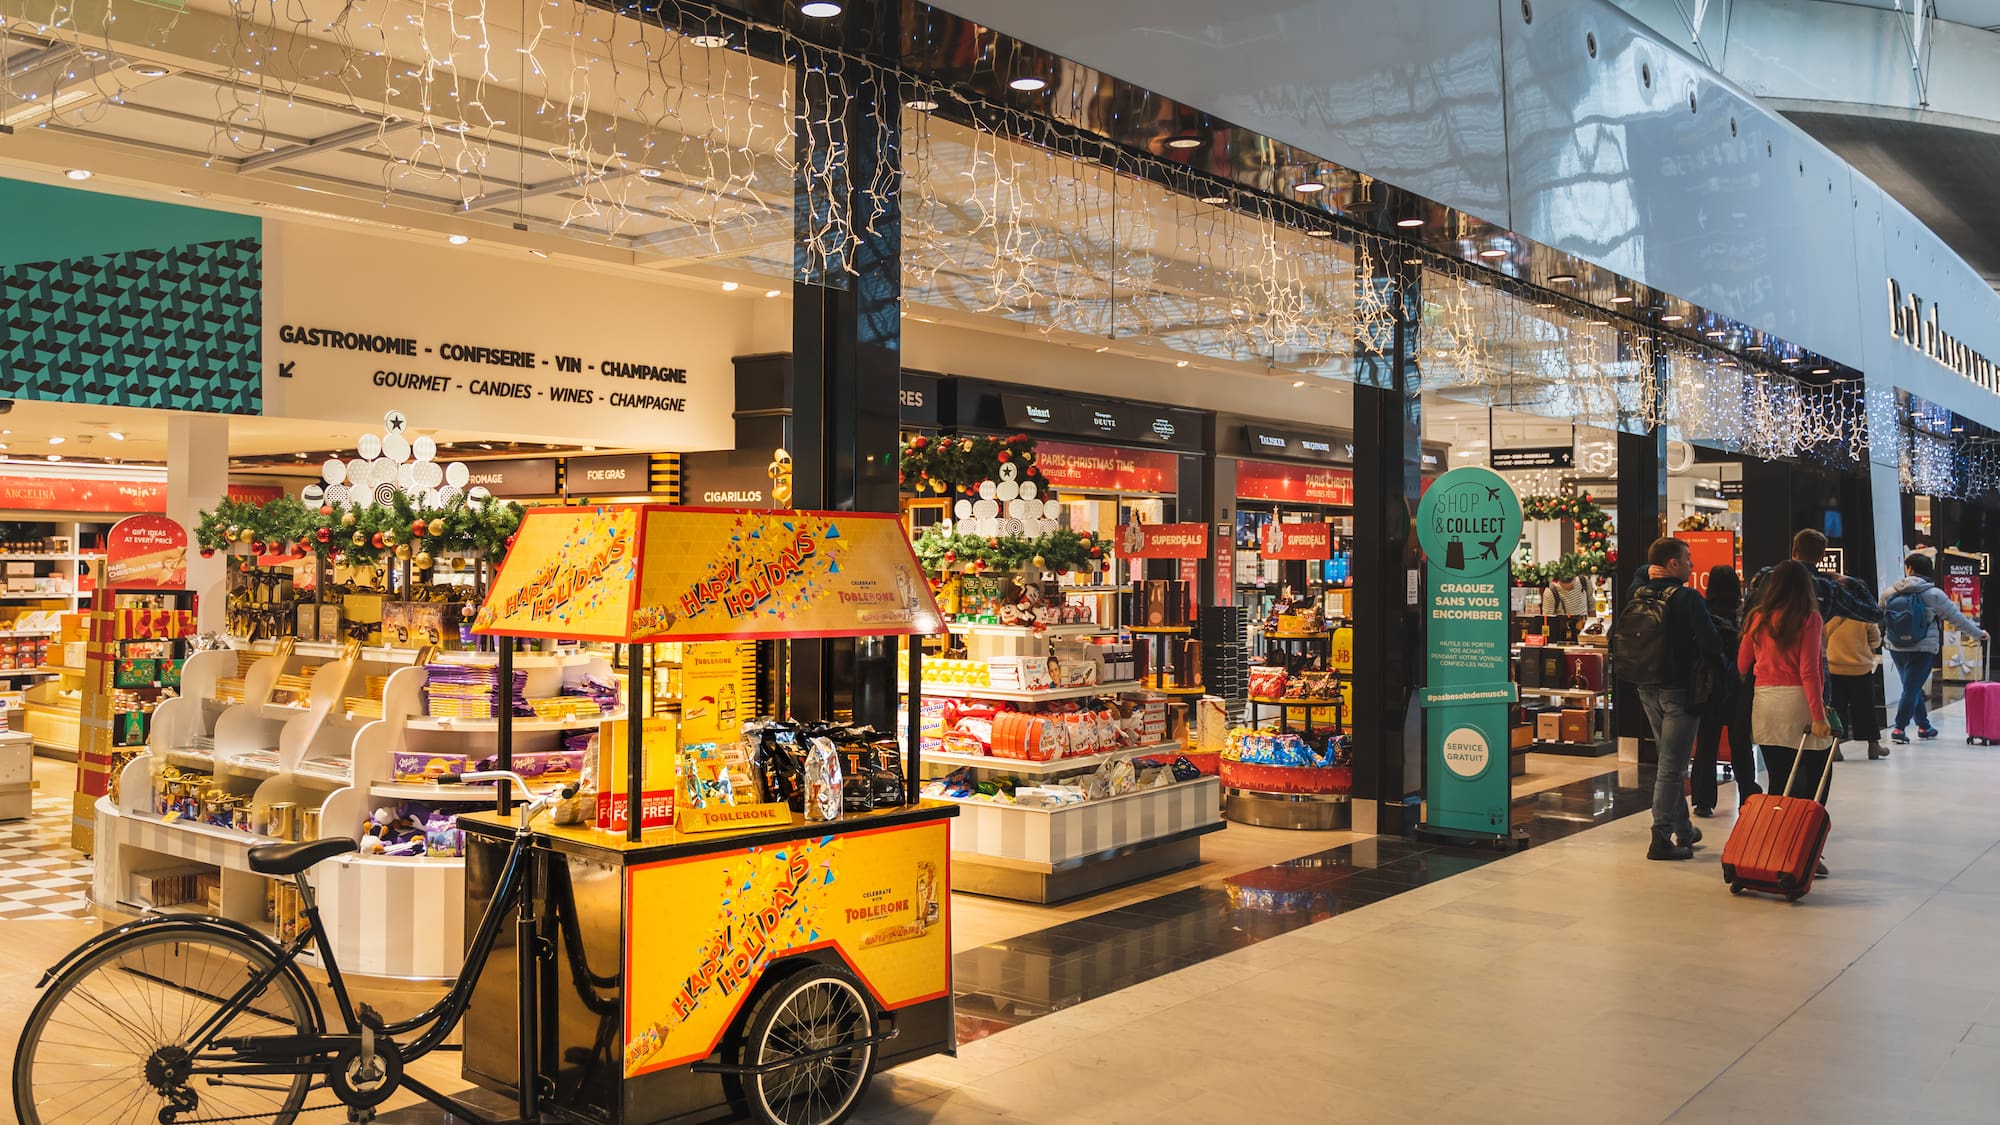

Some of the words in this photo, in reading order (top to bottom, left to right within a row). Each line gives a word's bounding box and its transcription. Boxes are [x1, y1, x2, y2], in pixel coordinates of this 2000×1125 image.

[279, 325, 417, 356] GASTRONOMIE
[440, 343, 535, 368] CONFISERIE
[555, 356, 582, 373] VIN
[600, 361, 687, 384] CHAMPAGNE
[373, 371, 452, 392] GOURMET
[469, 380, 532, 399] CANDIES
[550, 387, 594, 404] WINES
[610, 392, 686, 412] CHAMPAGNE
[1094, 418, 1116, 427] DEUTZ
[1042, 453, 1065, 466] PARIS
[1067, 456, 1114, 470] CHRISTMAS
[1116, 459, 1134, 472] TIME
[469, 474, 503, 484] ROMAGE
[587, 470, 604, 481] FOIE
[604, 469, 626, 480] GRAS
[1306, 474, 1324, 488] PARIS
[5, 487, 56, 500] ANGELINA
[704, 490, 762, 503] CIGARILLOS
[1438, 493, 1480, 514] SHOP
[1446, 518, 1506, 534] COLLECT
[1152, 534, 1202, 546] SUPERDEALS
[1288, 530, 1326, 546] SUPERDEALS
[108, 563, 126, 572] PARIS
[724, 530, 816, 618] HOLIDAYS
[532, 536, 626, 620] HOLIDAYS
[1952, 576, 1972, 584] -30%
[505, 564, 560, 618] HAPPY
[680, 558, 742, 618] HAPPY
[1440, 584, 1494, 594] CRAQUEZ
[838, 592, 896, 604] TOBLERONE
[1436, 597, 1465, 606] SANS
[1468, 598, 1500, 607] VOUS
[1432, 610, 1502, 620] ENCOMBRER
[696, 658, 732, 666] TOBLERONE
[1428, 690, 1508, 702] #pasbesoindemuscle
[1447, 743, 1483, 752] SERVICE
[513, 757, 536, 769] Milka
[1447, 753, 1484, 762] GRATUIT
[642, 804, 672, 819] FREE
[703, 809, 776, 825] TOBLERONE
[863, 888, 892, 898] CELEBRATE
[845, 899, 909, 924] TOBLERONE
[716, 850, 810, 997] HOLIDAYS
[672, 925, 734, 1022] HAPPY
